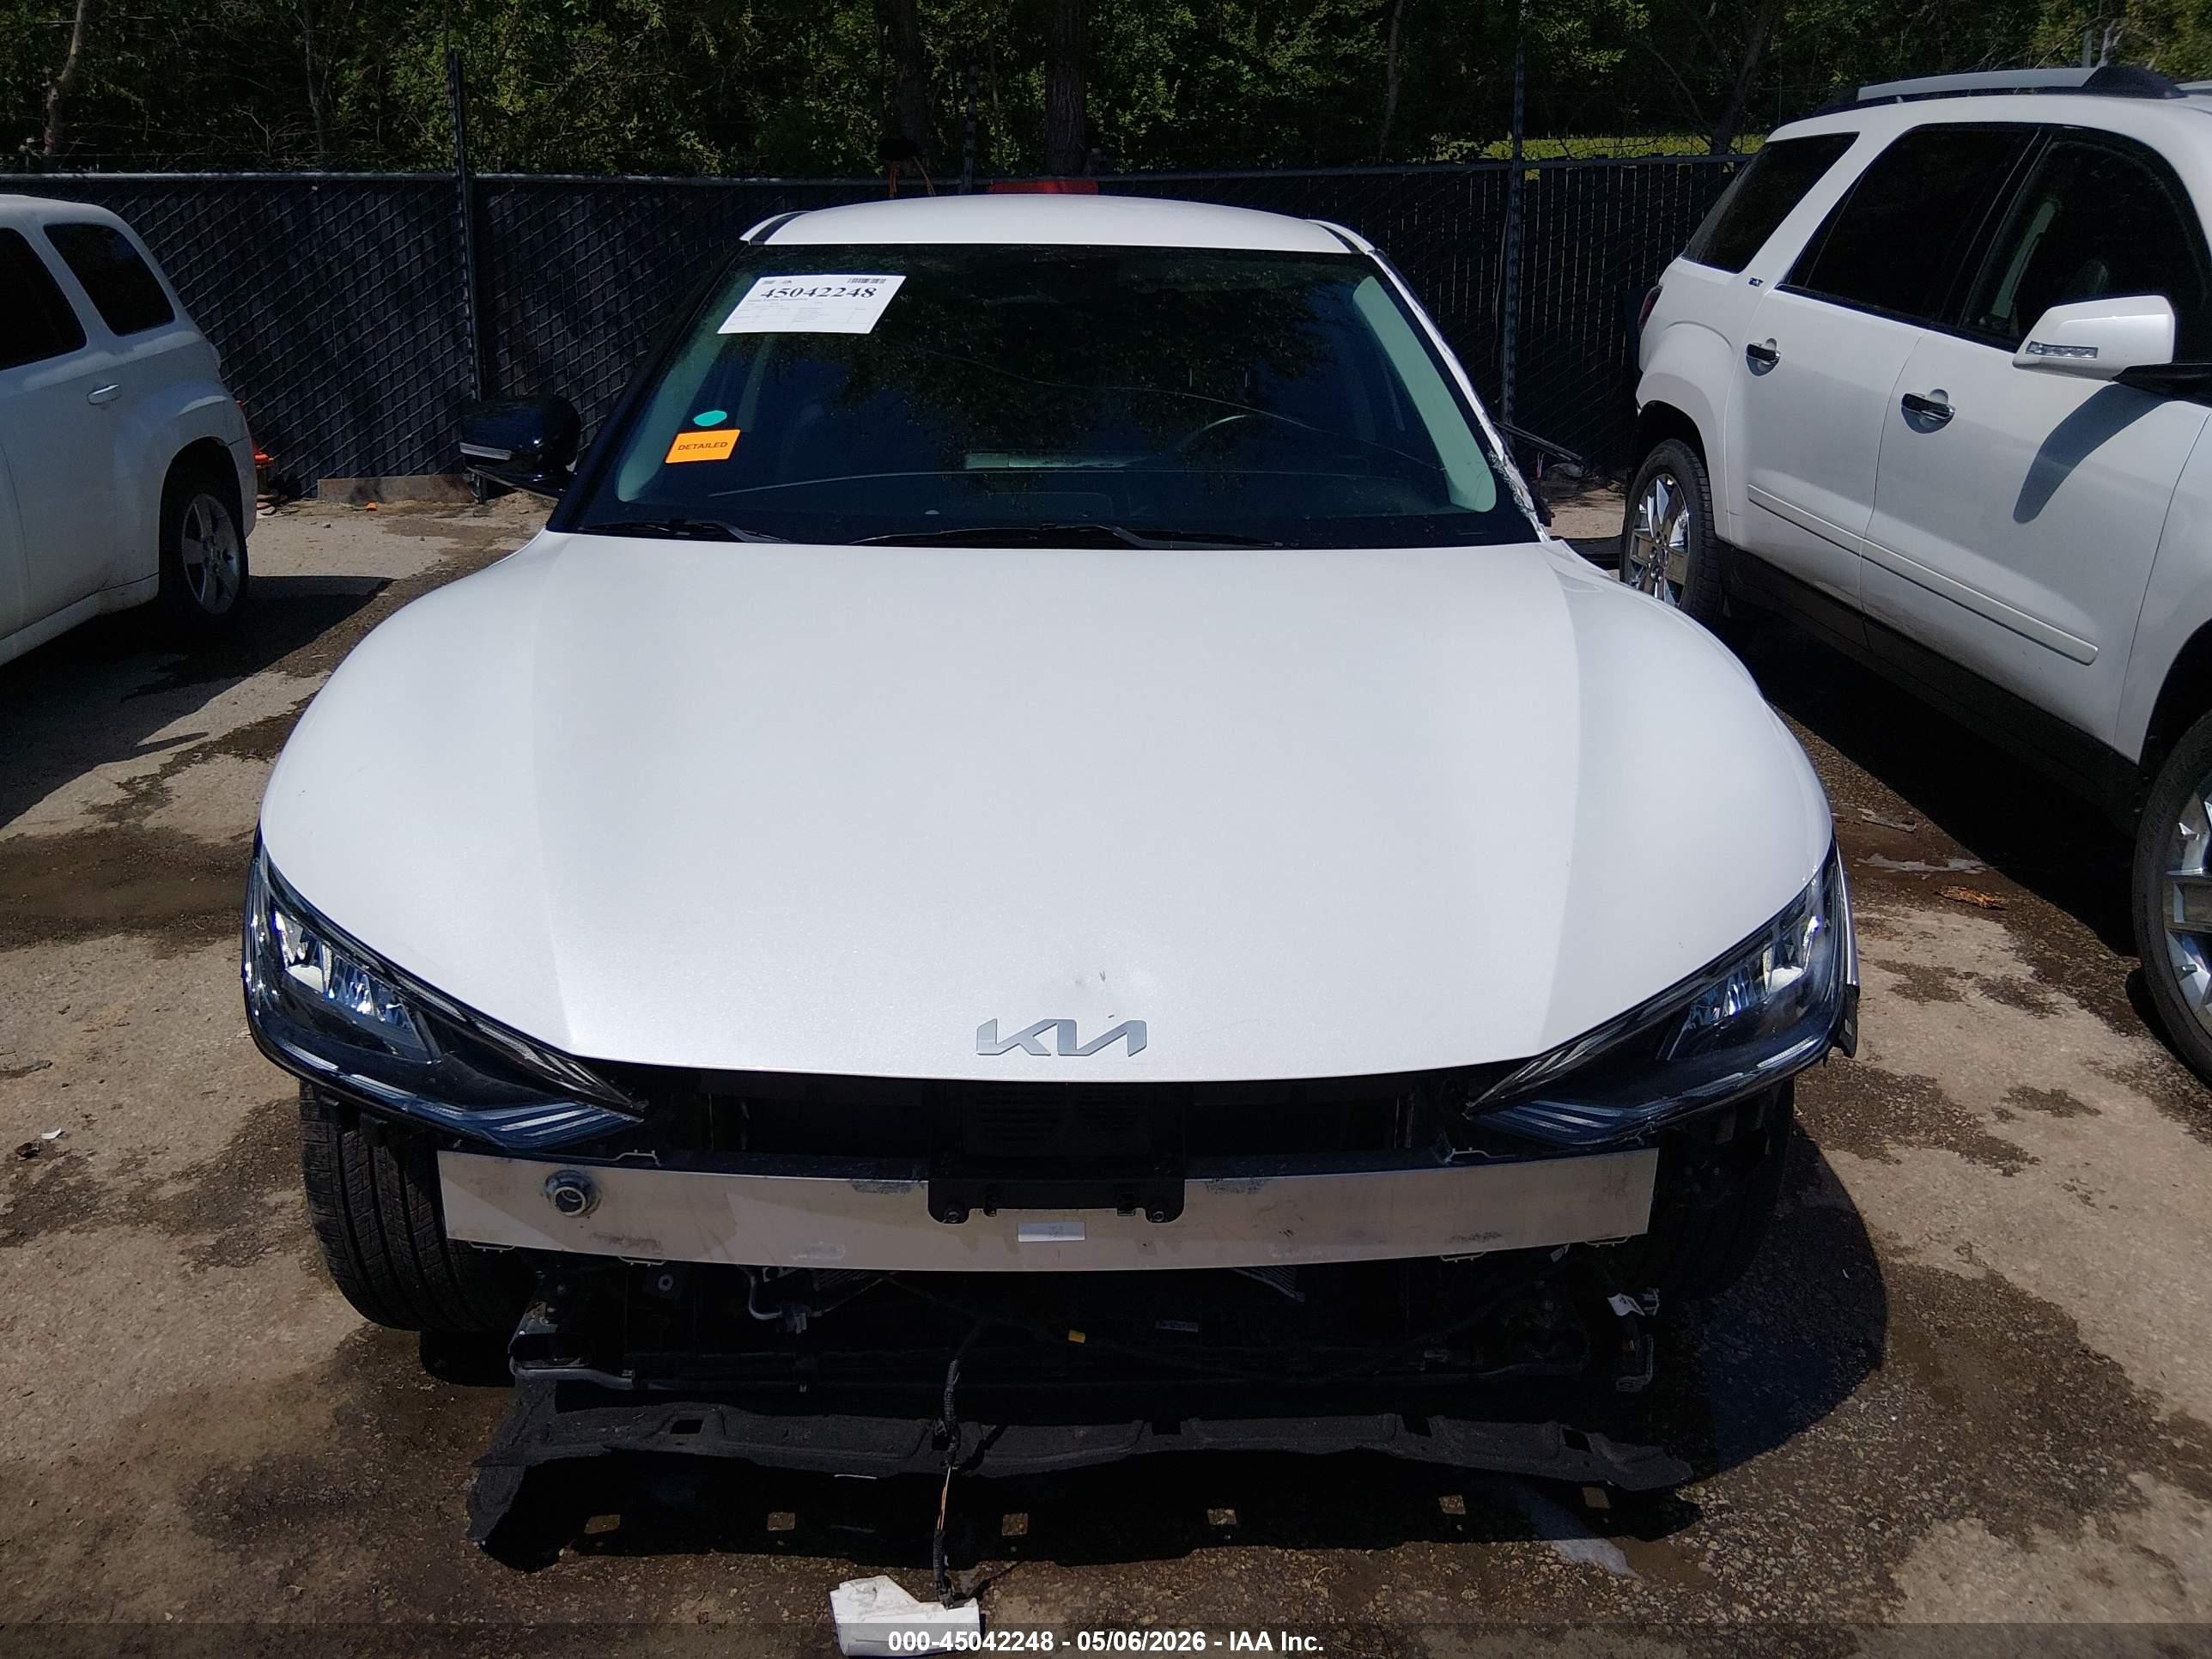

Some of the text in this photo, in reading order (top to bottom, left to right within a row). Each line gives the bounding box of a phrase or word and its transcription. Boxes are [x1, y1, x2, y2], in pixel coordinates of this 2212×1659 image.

[761, 287, 878, 299] 45042248
[677, 441, 728, 451] DETAILED
[976, 1018, 1147, 1057] KIA
